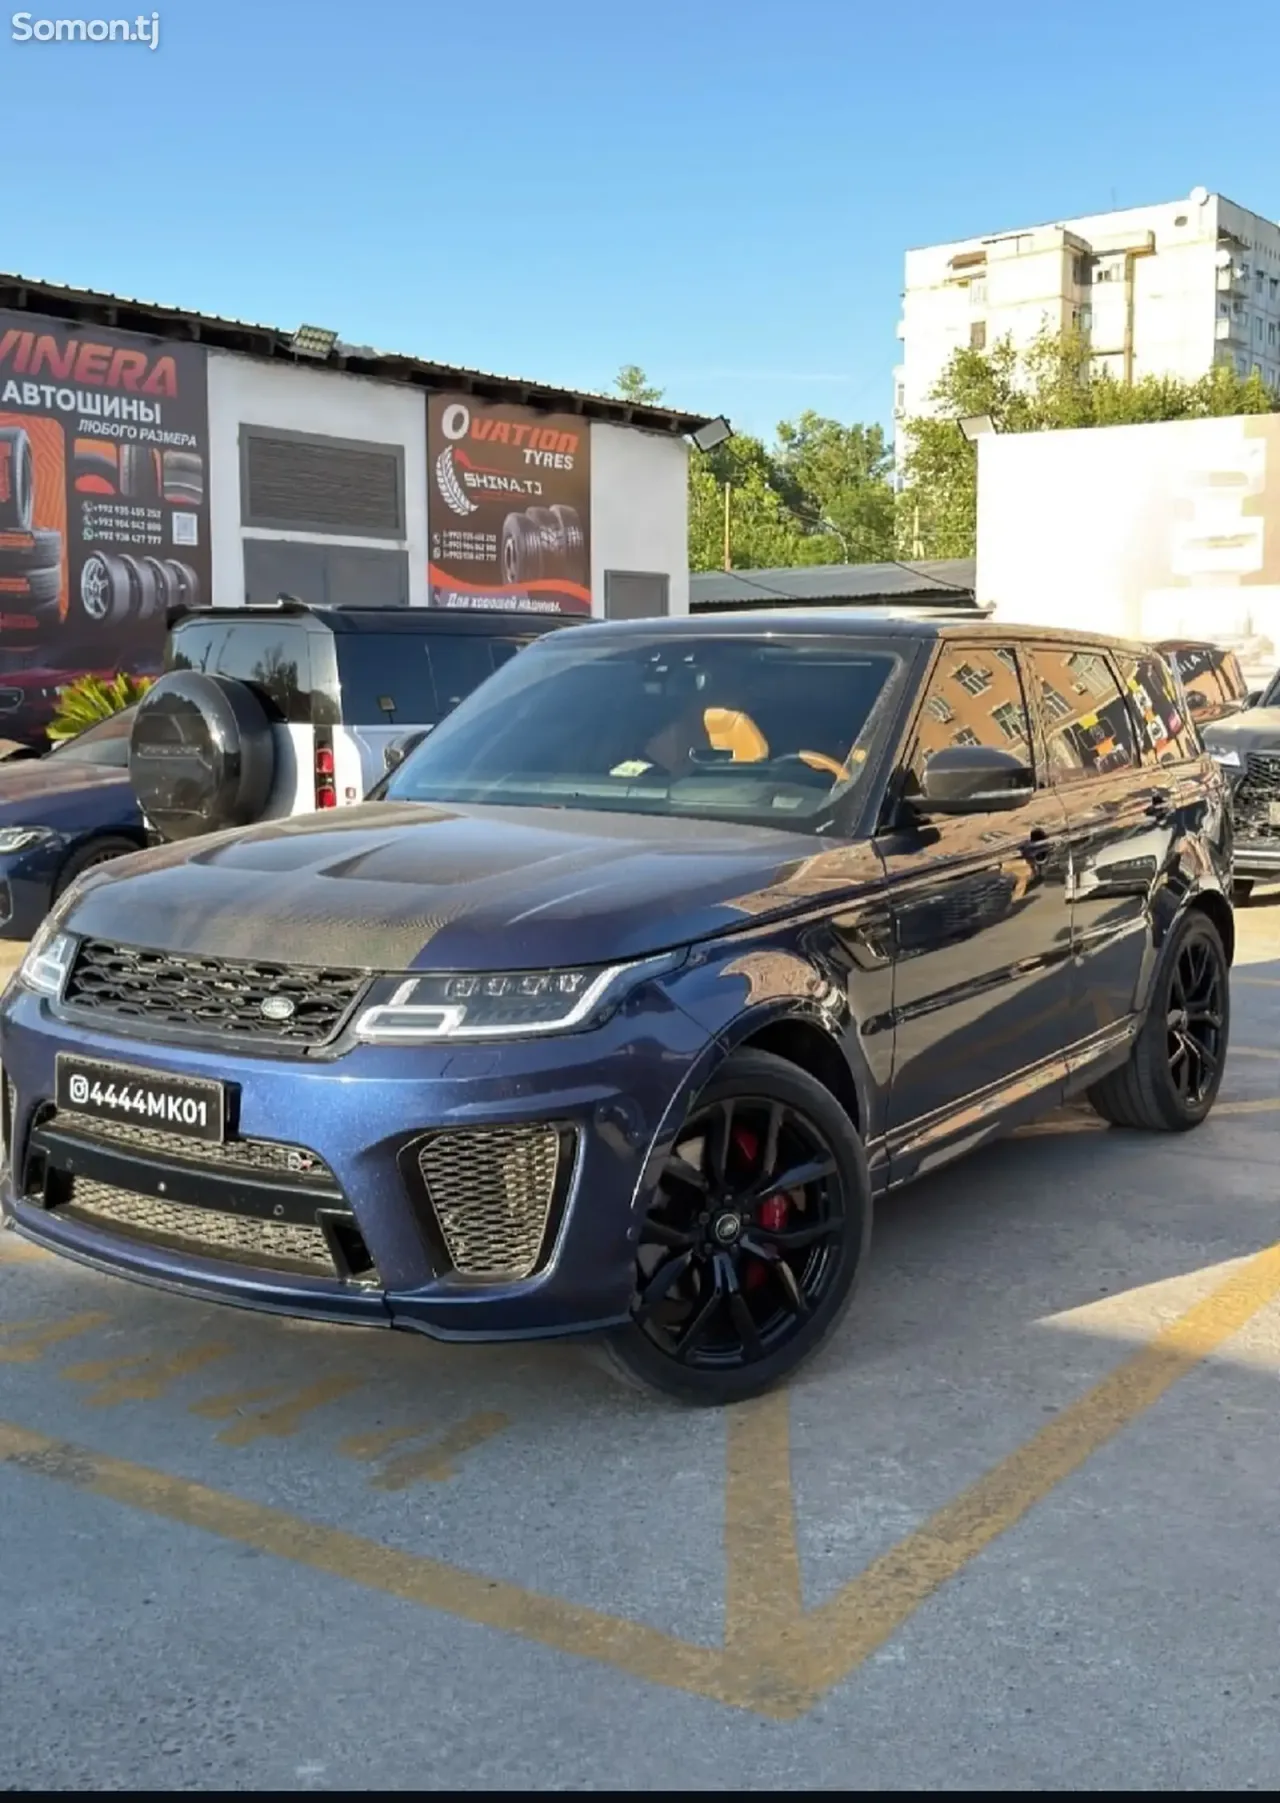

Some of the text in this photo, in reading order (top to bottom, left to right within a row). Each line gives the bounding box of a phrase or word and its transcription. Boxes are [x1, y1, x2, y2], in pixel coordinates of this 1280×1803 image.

[2, 379, 162, 425] АВТОШИНЫ
[78, 418, 197, 447] ЛЮБОГО РАЗМЕРА
[523, 449, 574, 471] TYRES
